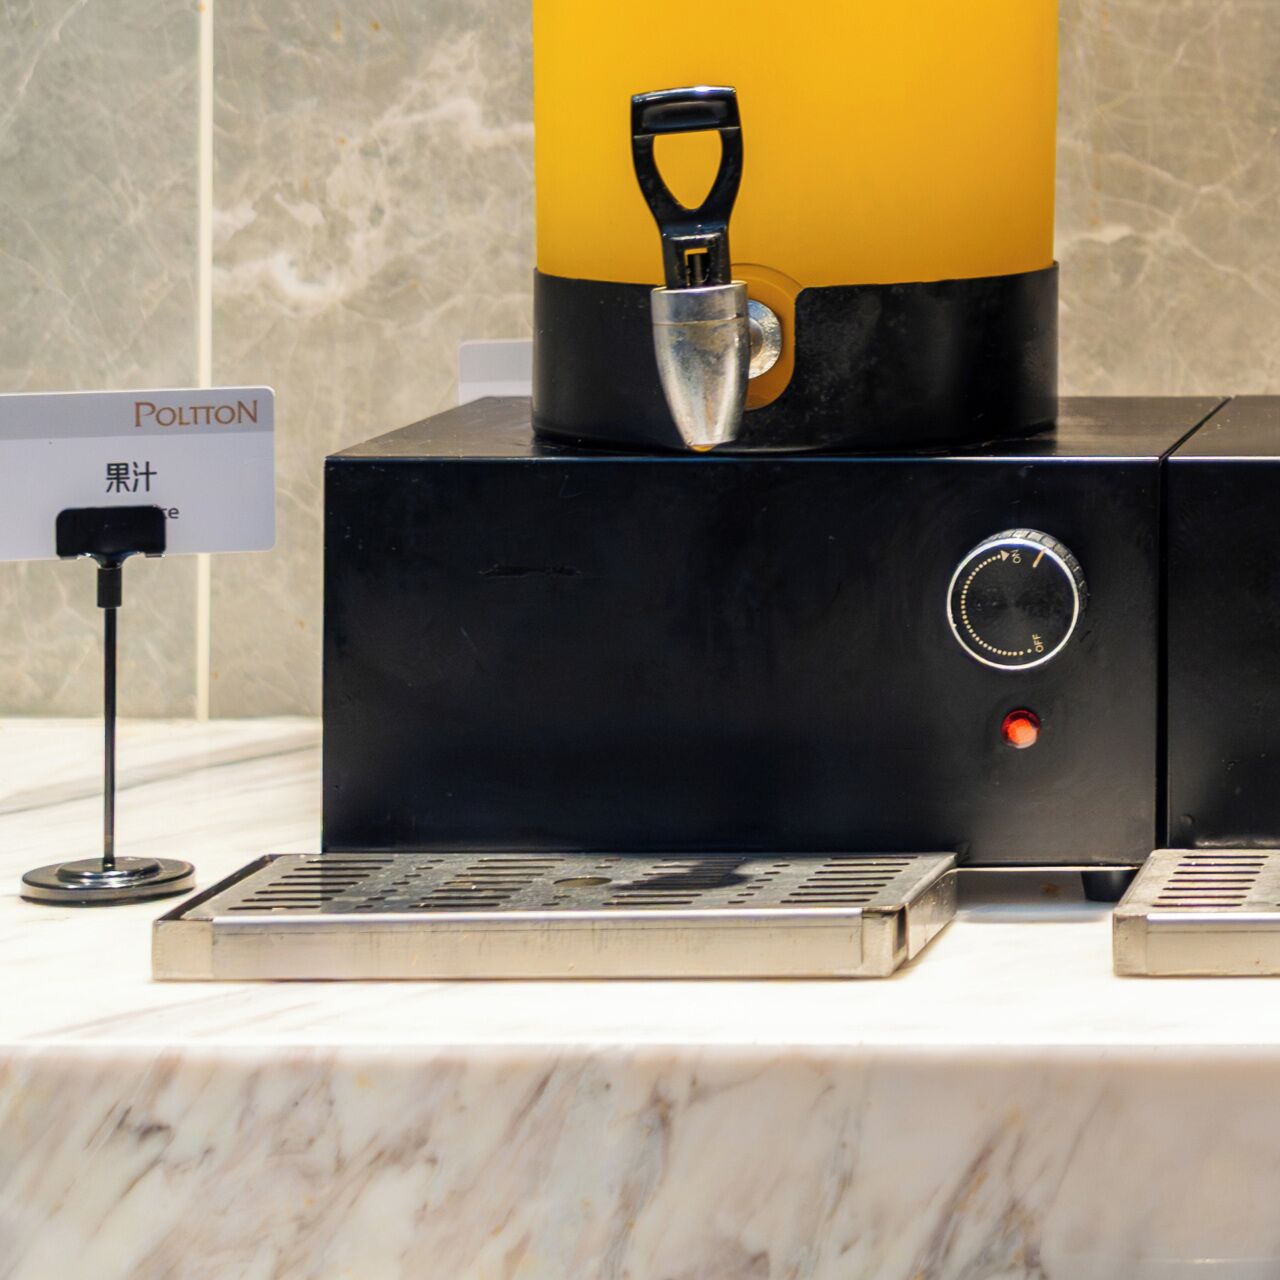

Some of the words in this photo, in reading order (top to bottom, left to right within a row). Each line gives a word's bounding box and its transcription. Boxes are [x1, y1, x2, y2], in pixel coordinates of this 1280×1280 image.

[134, 400, 259, 427] POLTTON
[106, 461, 157, 493] 果汁
[1032, 633, 1044, 653] OFF
